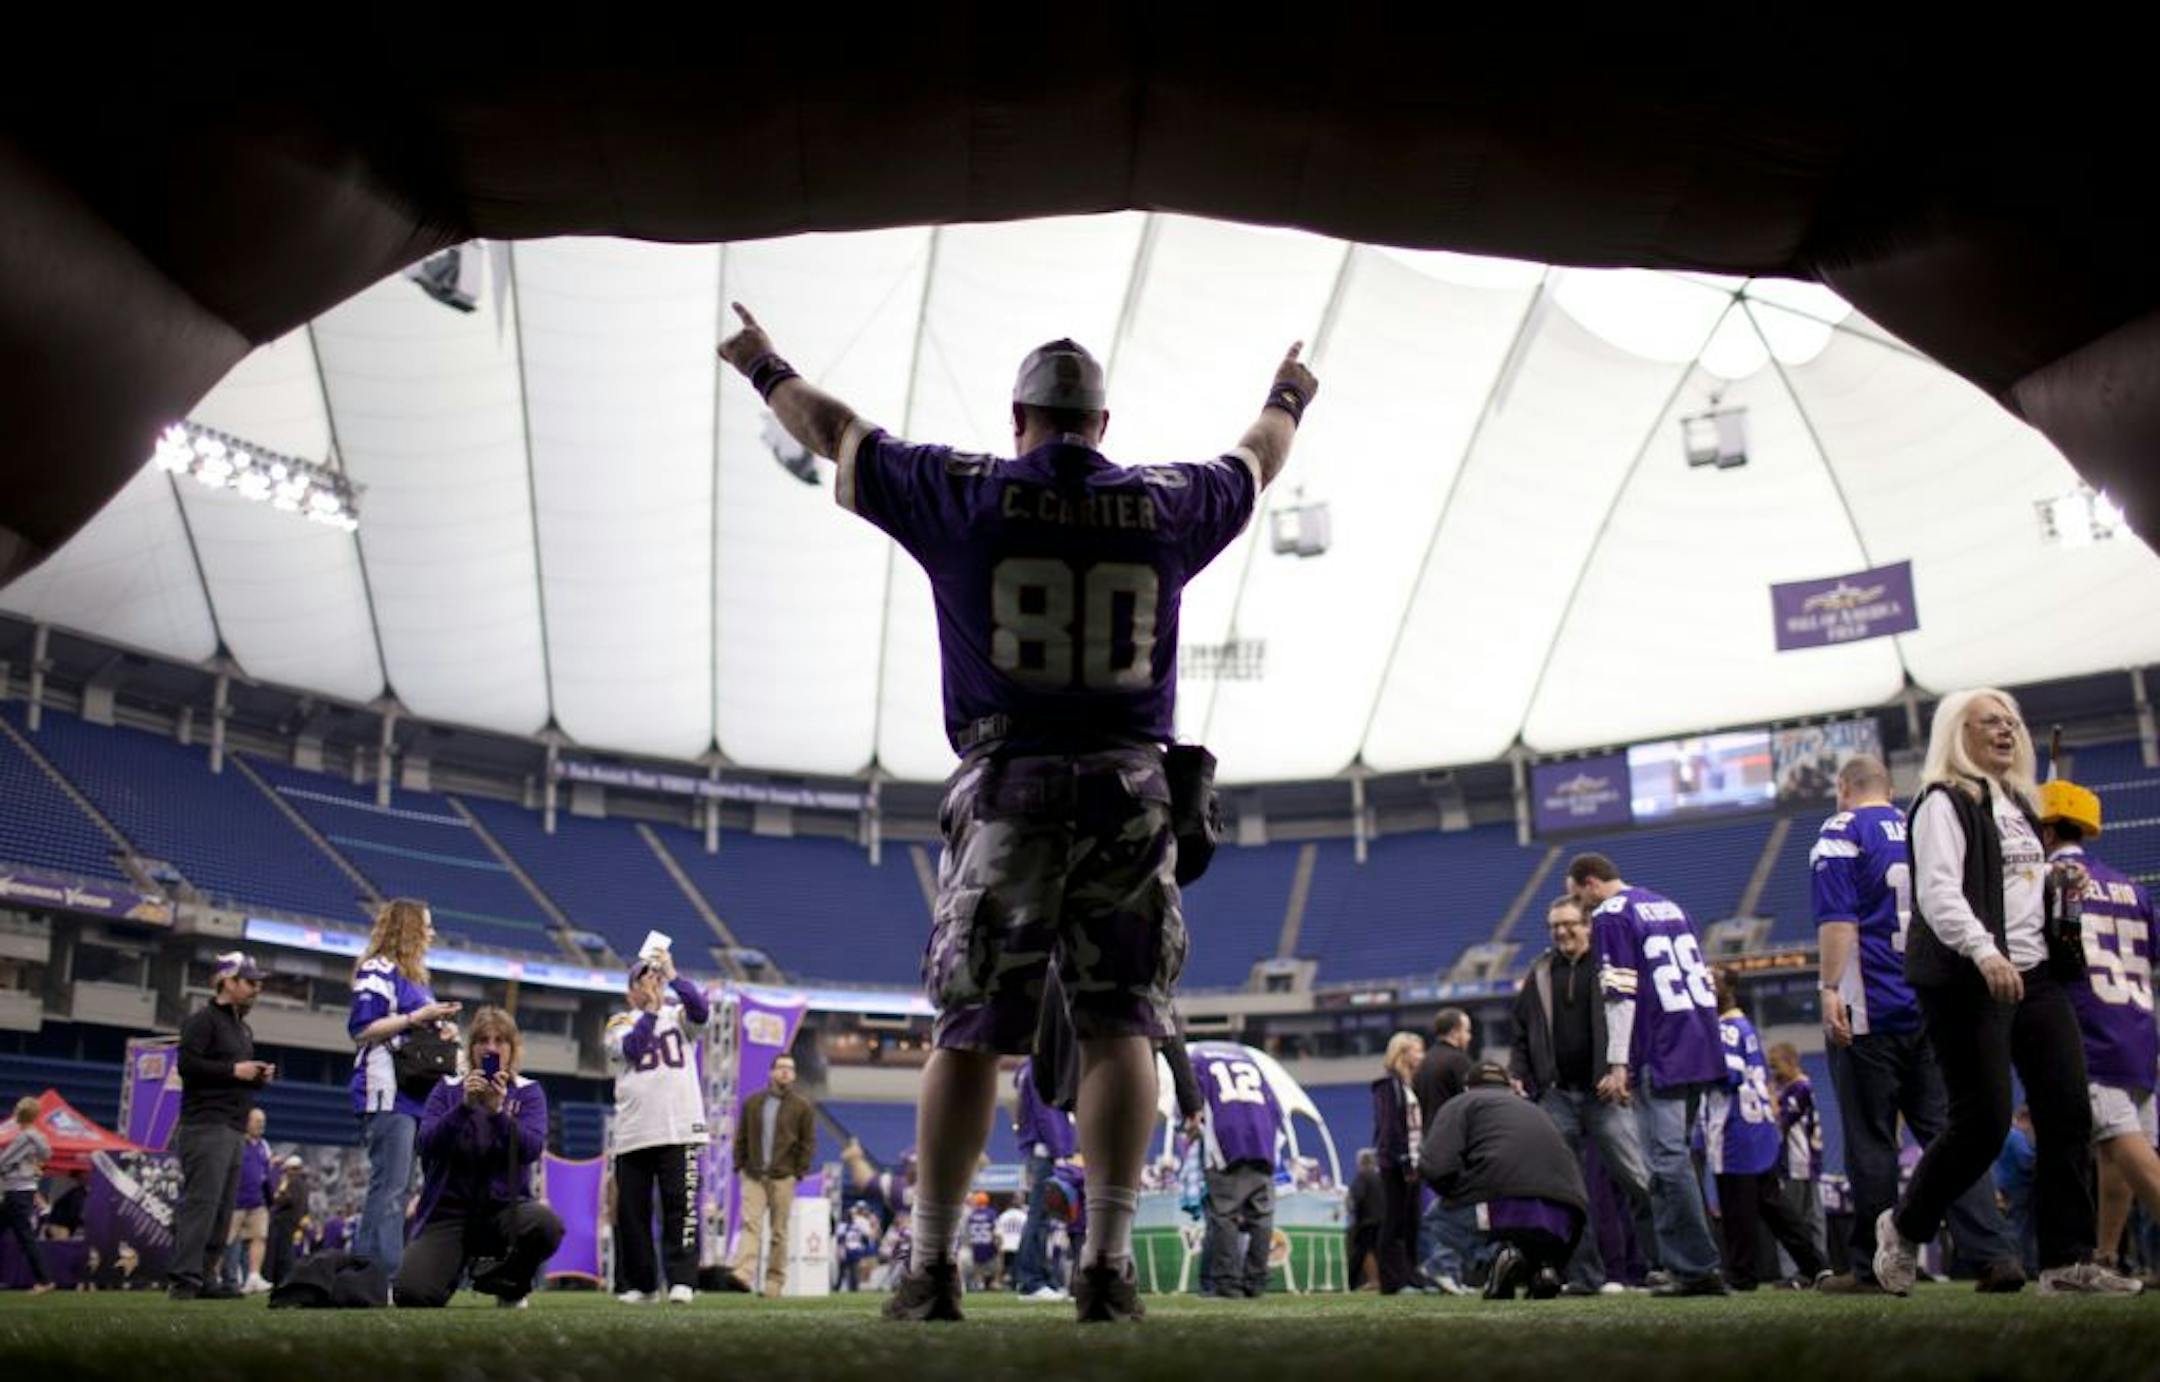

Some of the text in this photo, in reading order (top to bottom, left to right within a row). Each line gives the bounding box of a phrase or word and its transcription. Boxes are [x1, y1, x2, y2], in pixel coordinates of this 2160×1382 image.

[1036, 489, 1157, 530] CARTER
[991, 556, 1159, 691] 80
[1643, 933, 1717, 1012] 28
[2080, 912, 2154, 1011] 55
[1208, 1060, 1266, 1105] 12
